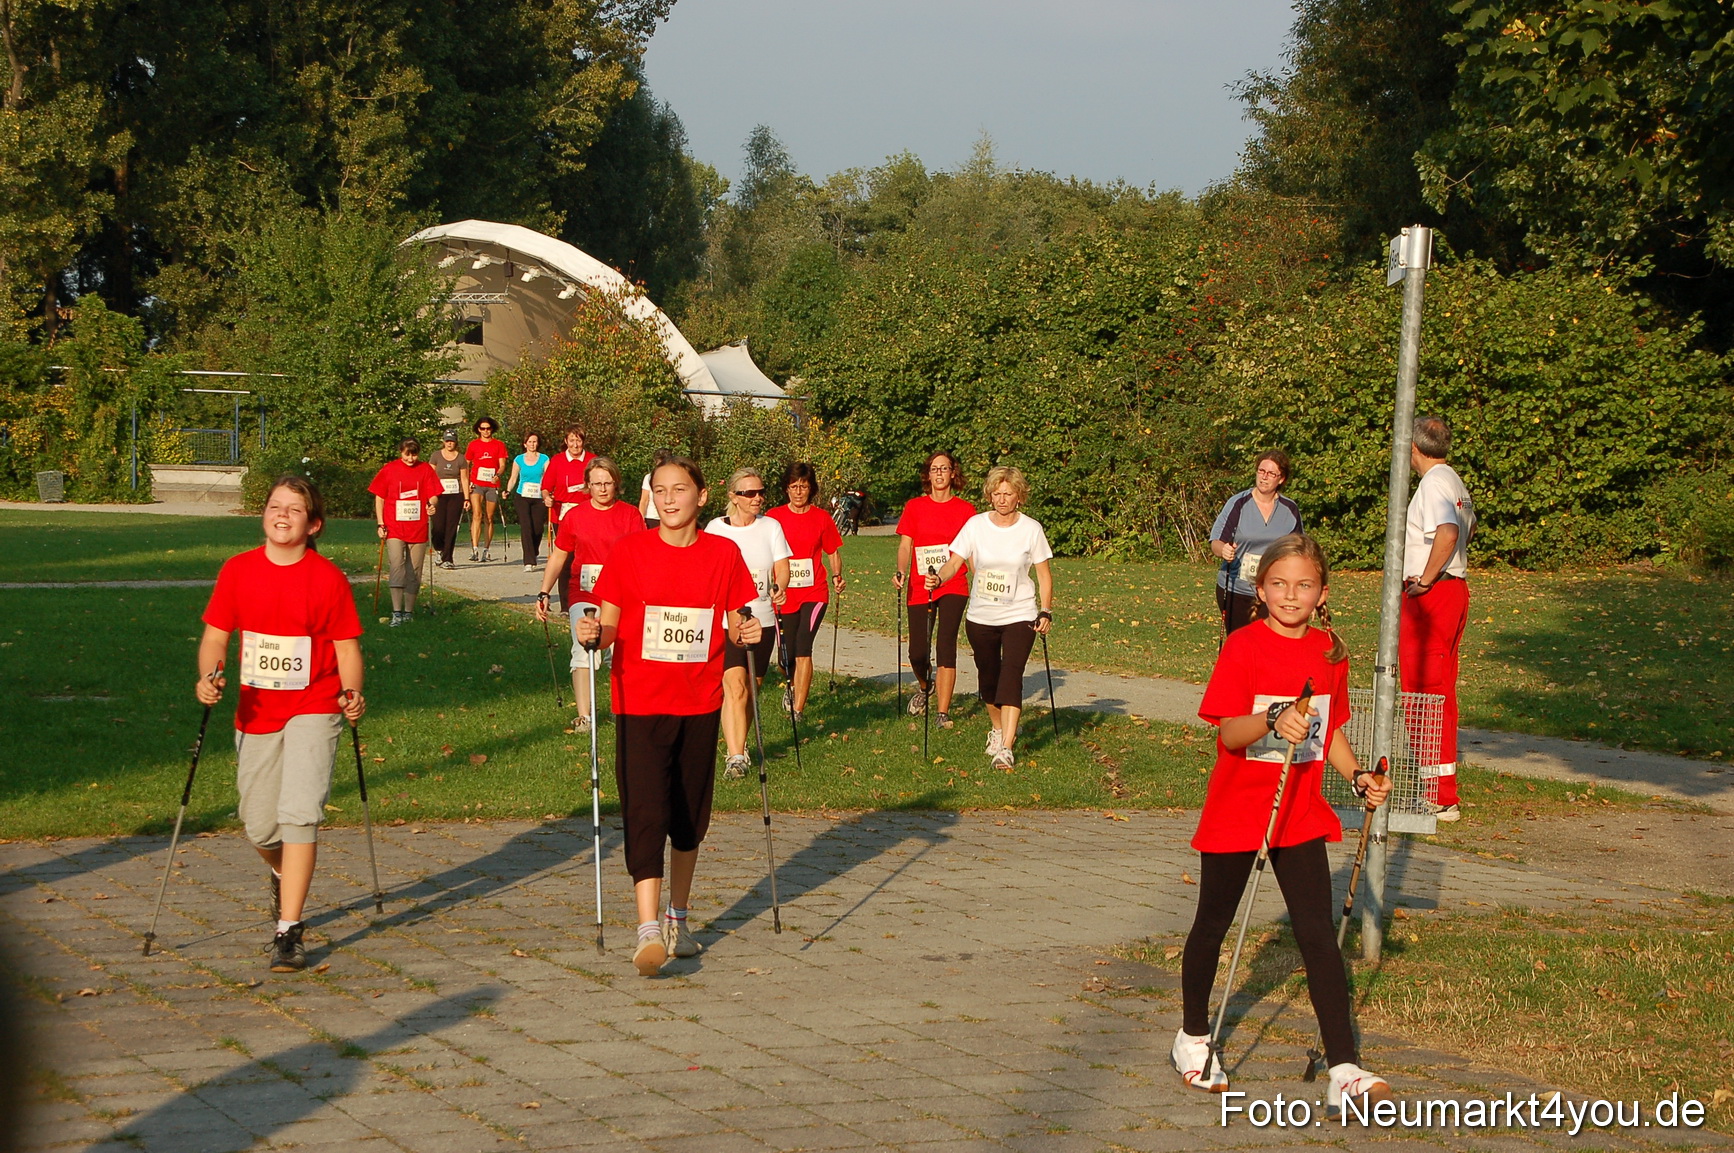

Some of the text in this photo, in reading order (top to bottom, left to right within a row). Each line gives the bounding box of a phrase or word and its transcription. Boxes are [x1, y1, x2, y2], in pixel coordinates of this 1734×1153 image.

[925, 555, 948, 565] 8068
[986, 582, 1011, 594] 8001
[664, 611, 688, 624] Nadja
[663, 628, 704, 644] 8064
[259, 638, 280, 650] Jana
[259, 656, 302, 672] 8063
